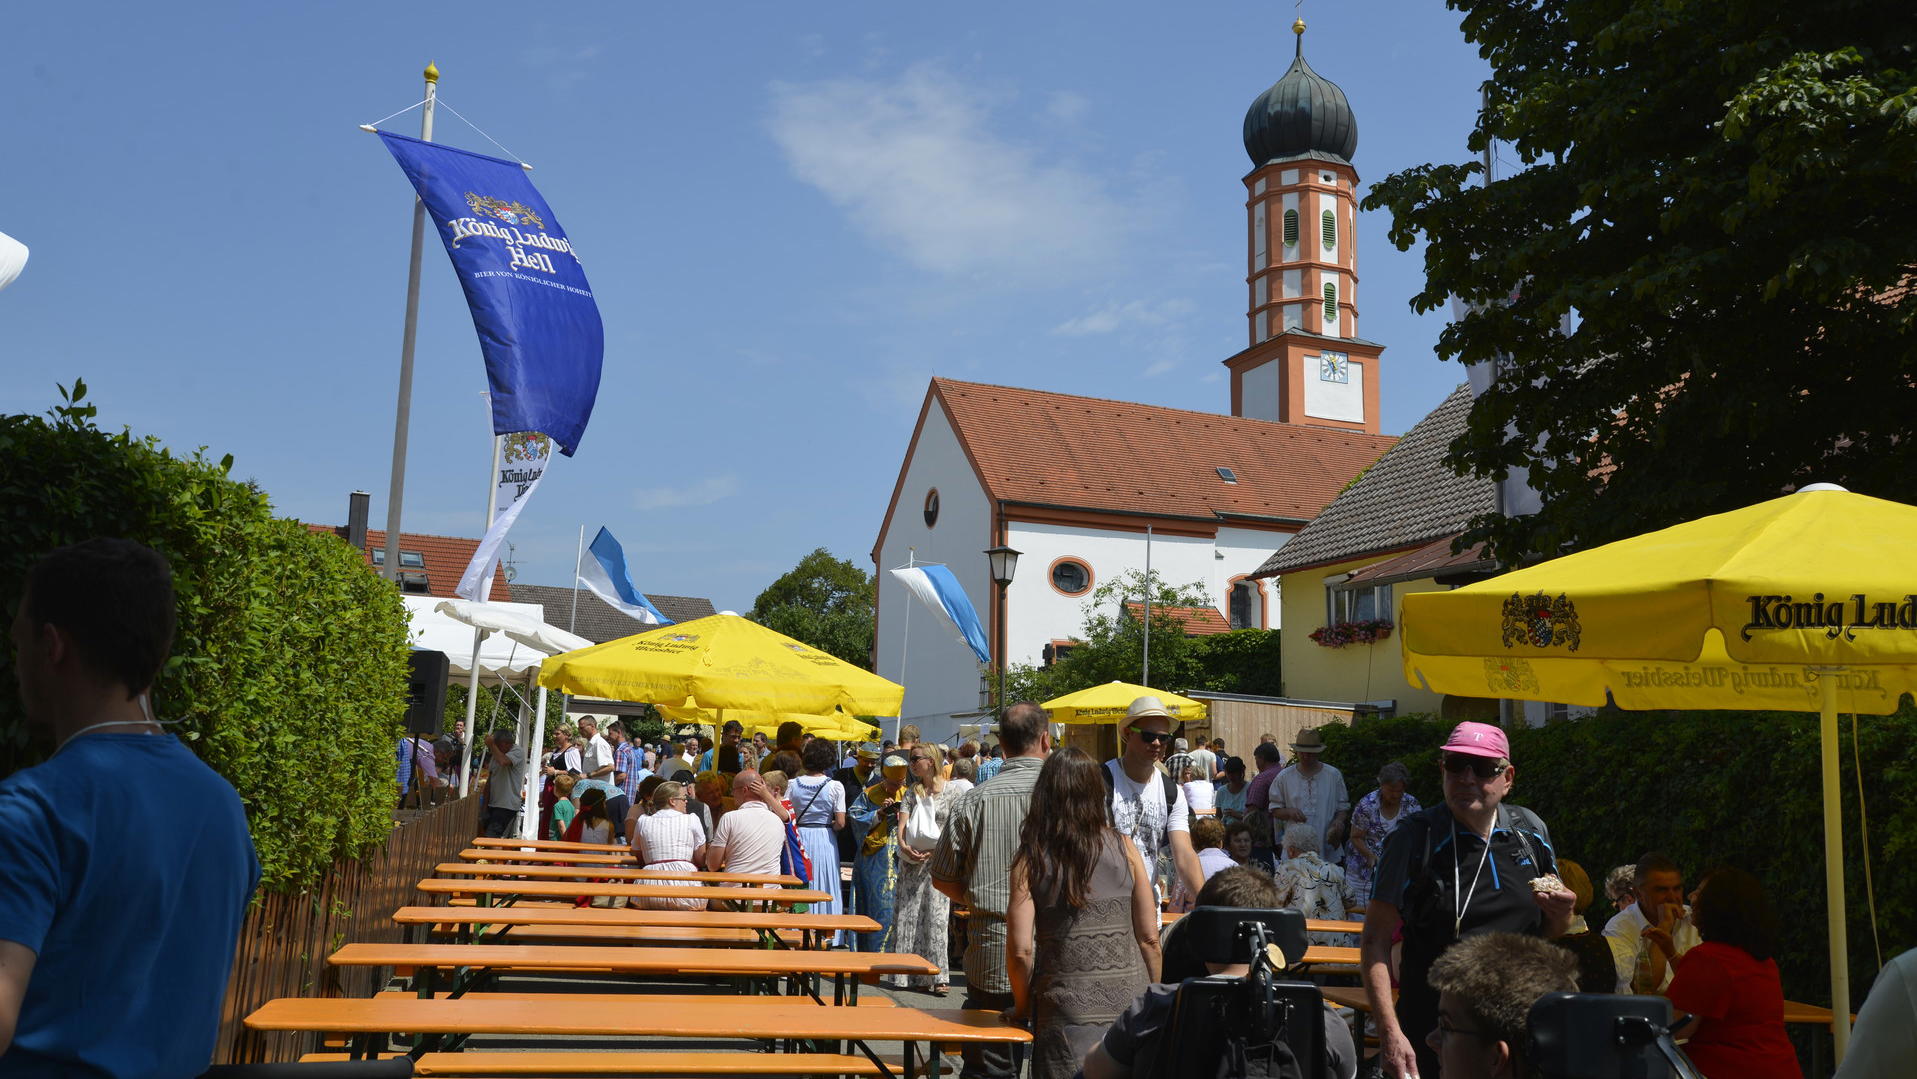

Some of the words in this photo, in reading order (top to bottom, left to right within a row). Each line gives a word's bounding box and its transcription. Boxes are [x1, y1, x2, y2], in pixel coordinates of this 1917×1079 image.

[447, 217, 514, 249] König
[510, 226, 581, 264] Ludwi
[505, 245, 556, 275] Hell
[474, 270, 495, 278] BIER
[496, 270, 513, 278] VON
[499, 468, 528, 488] König
[1741, 592, 1844, 642] König
[1473, 731, 1485, 743] T
